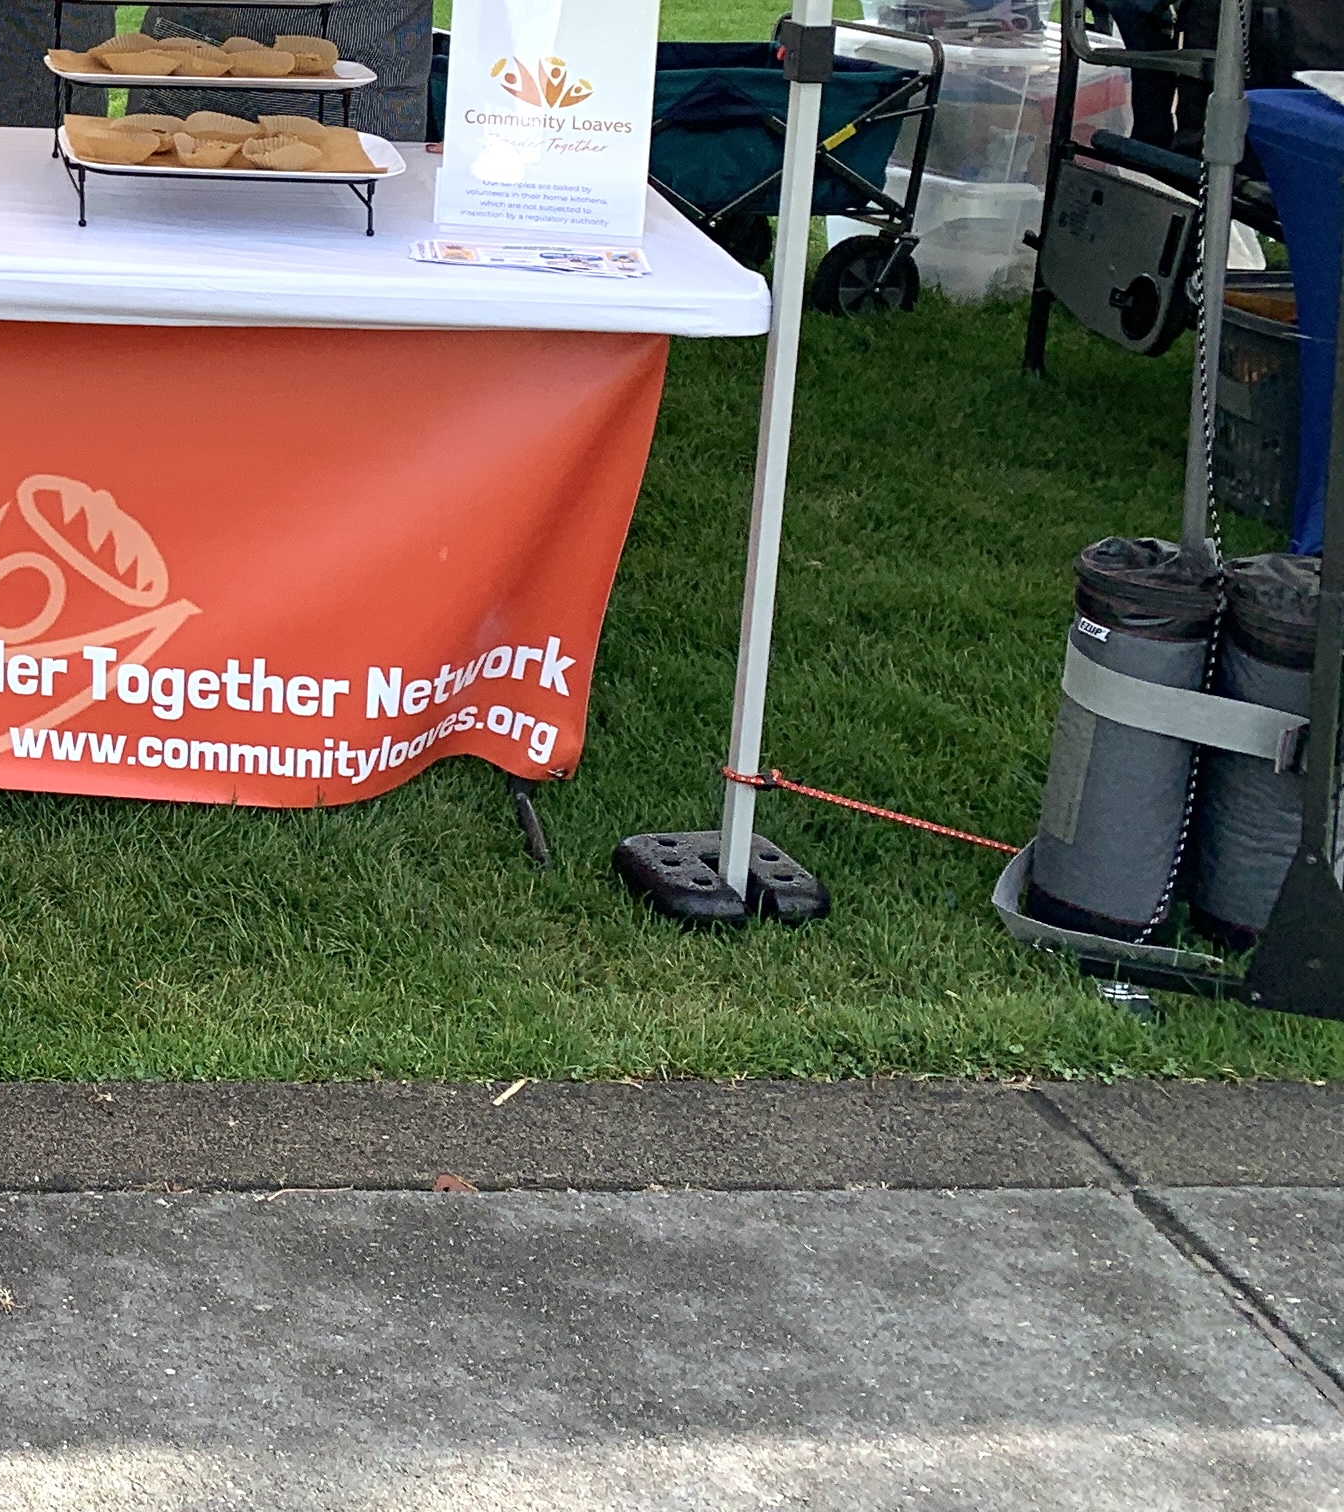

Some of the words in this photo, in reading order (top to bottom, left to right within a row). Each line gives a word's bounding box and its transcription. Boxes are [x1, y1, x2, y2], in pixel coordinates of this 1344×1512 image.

[465, 109, 565, 132] Community
[572, 116, 632, 133] Loaves
[547, 138, 608, 154] Together
[83, 646, 351, 720] Together
[366, 637, 576, 720] Network
[9, 702, 557, 783] www.communityloaves.org
